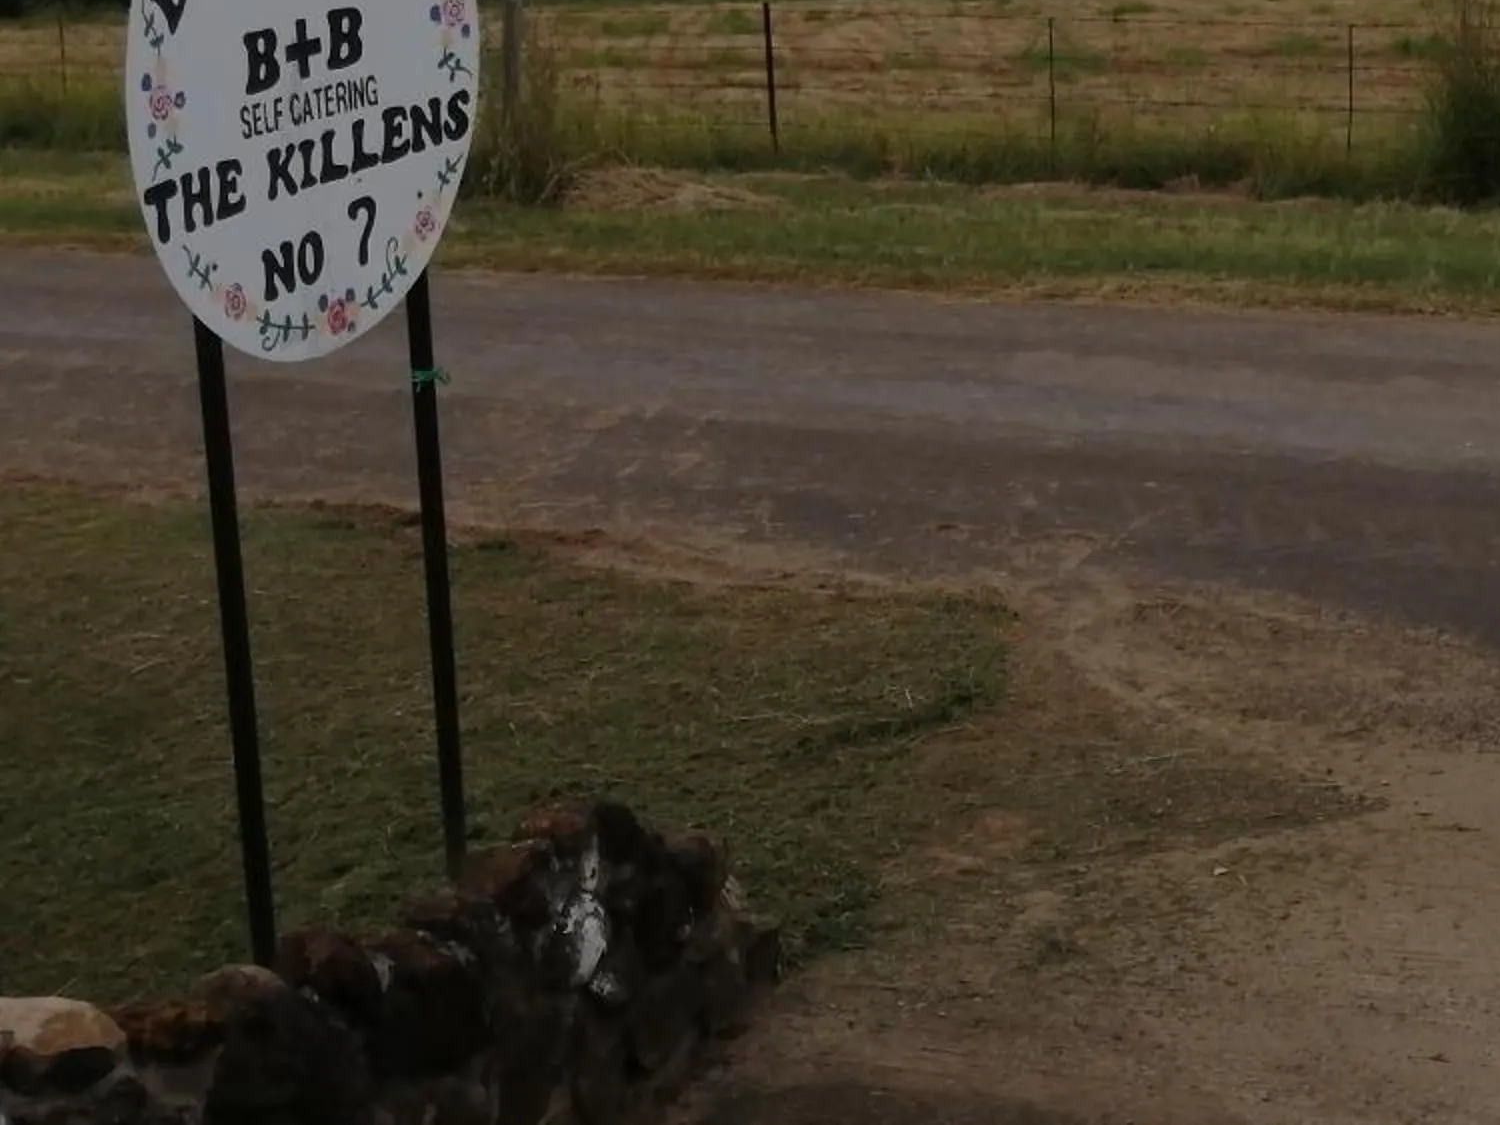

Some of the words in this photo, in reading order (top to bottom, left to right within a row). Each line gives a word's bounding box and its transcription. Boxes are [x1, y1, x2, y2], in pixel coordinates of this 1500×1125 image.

[244, 6, 363, 94] B+B
[239, 94, 284, 139] SELF
[289, 75, 380, 122] CATERING
[144, 158, 246, 243] THE
[267, 89, 470, 200] KILLENS
[261, 230, 323, 301] NO
